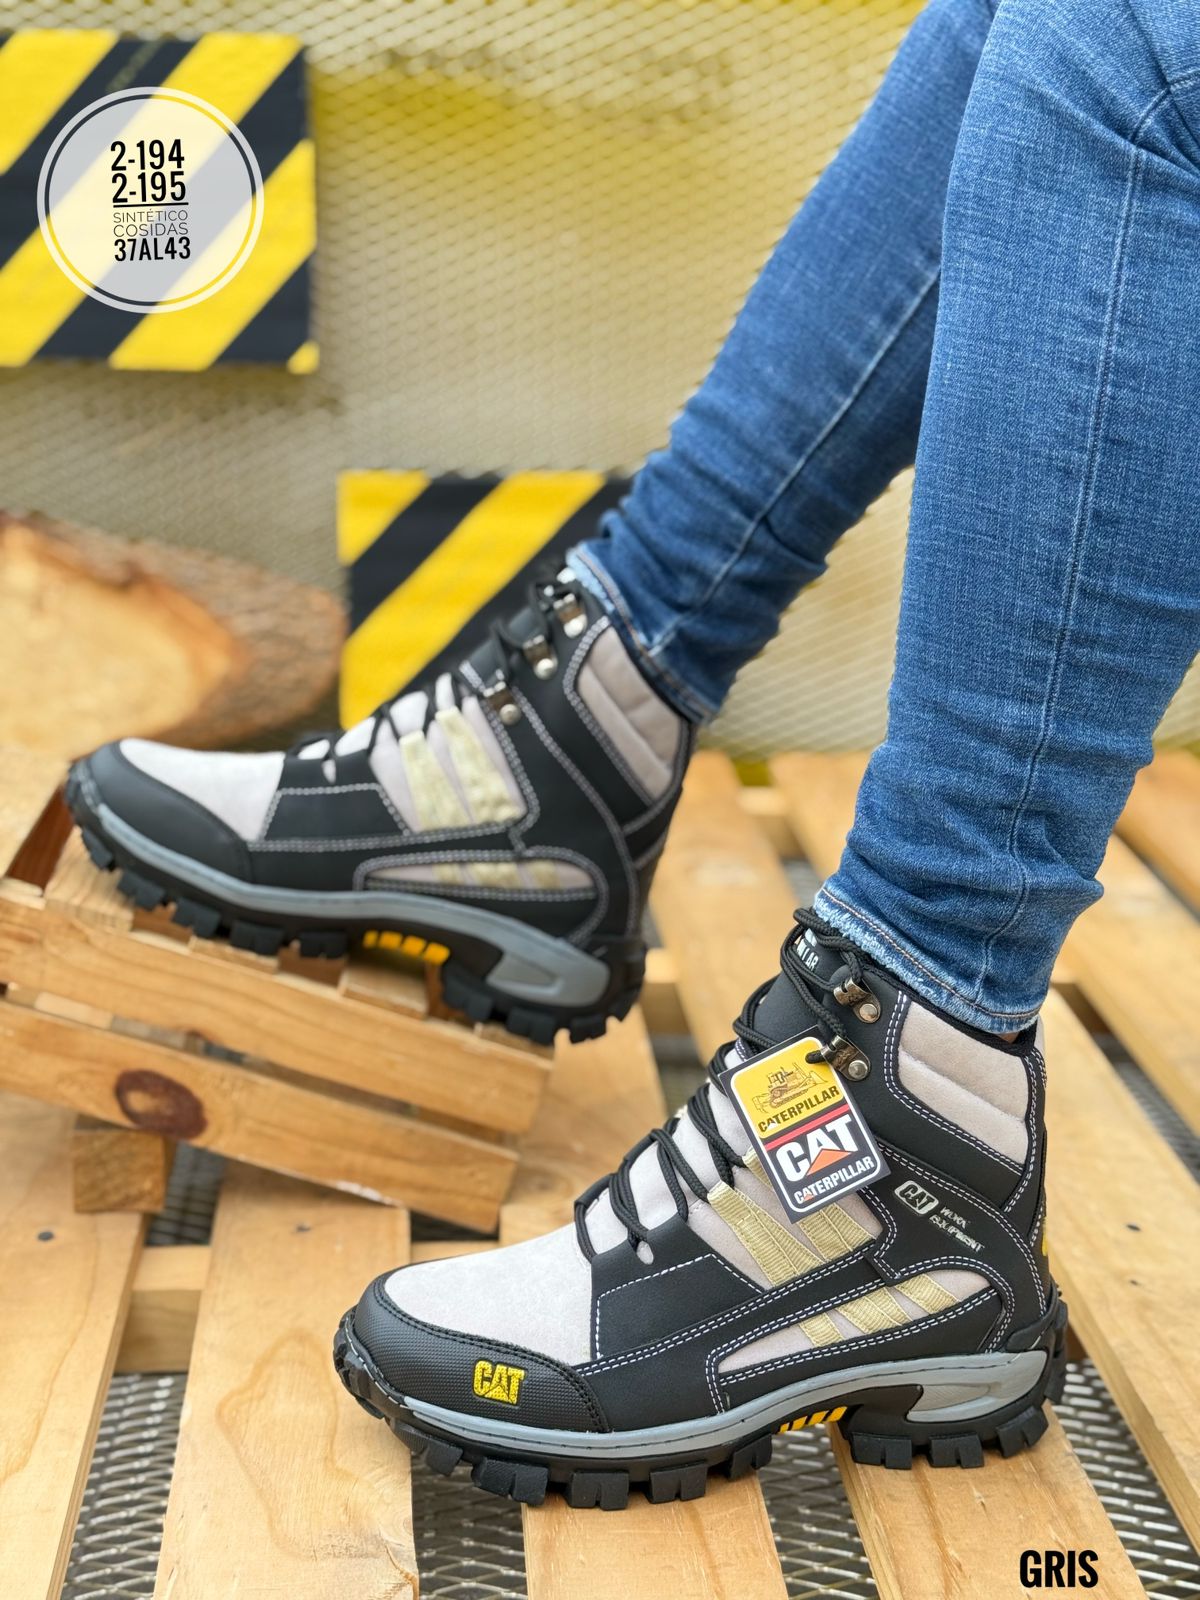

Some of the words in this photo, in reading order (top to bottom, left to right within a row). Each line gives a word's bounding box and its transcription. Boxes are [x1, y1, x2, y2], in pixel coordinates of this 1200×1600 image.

[757, 1085, 840, 1133] CATERPILLAR
[775, 1114, 859, 1182] CAT
[793, 1156, 875, 1204] CATERPILLAR
[898, 1184, 935, 1211] CAT
[473, 1360, 525, 1405] CAT
